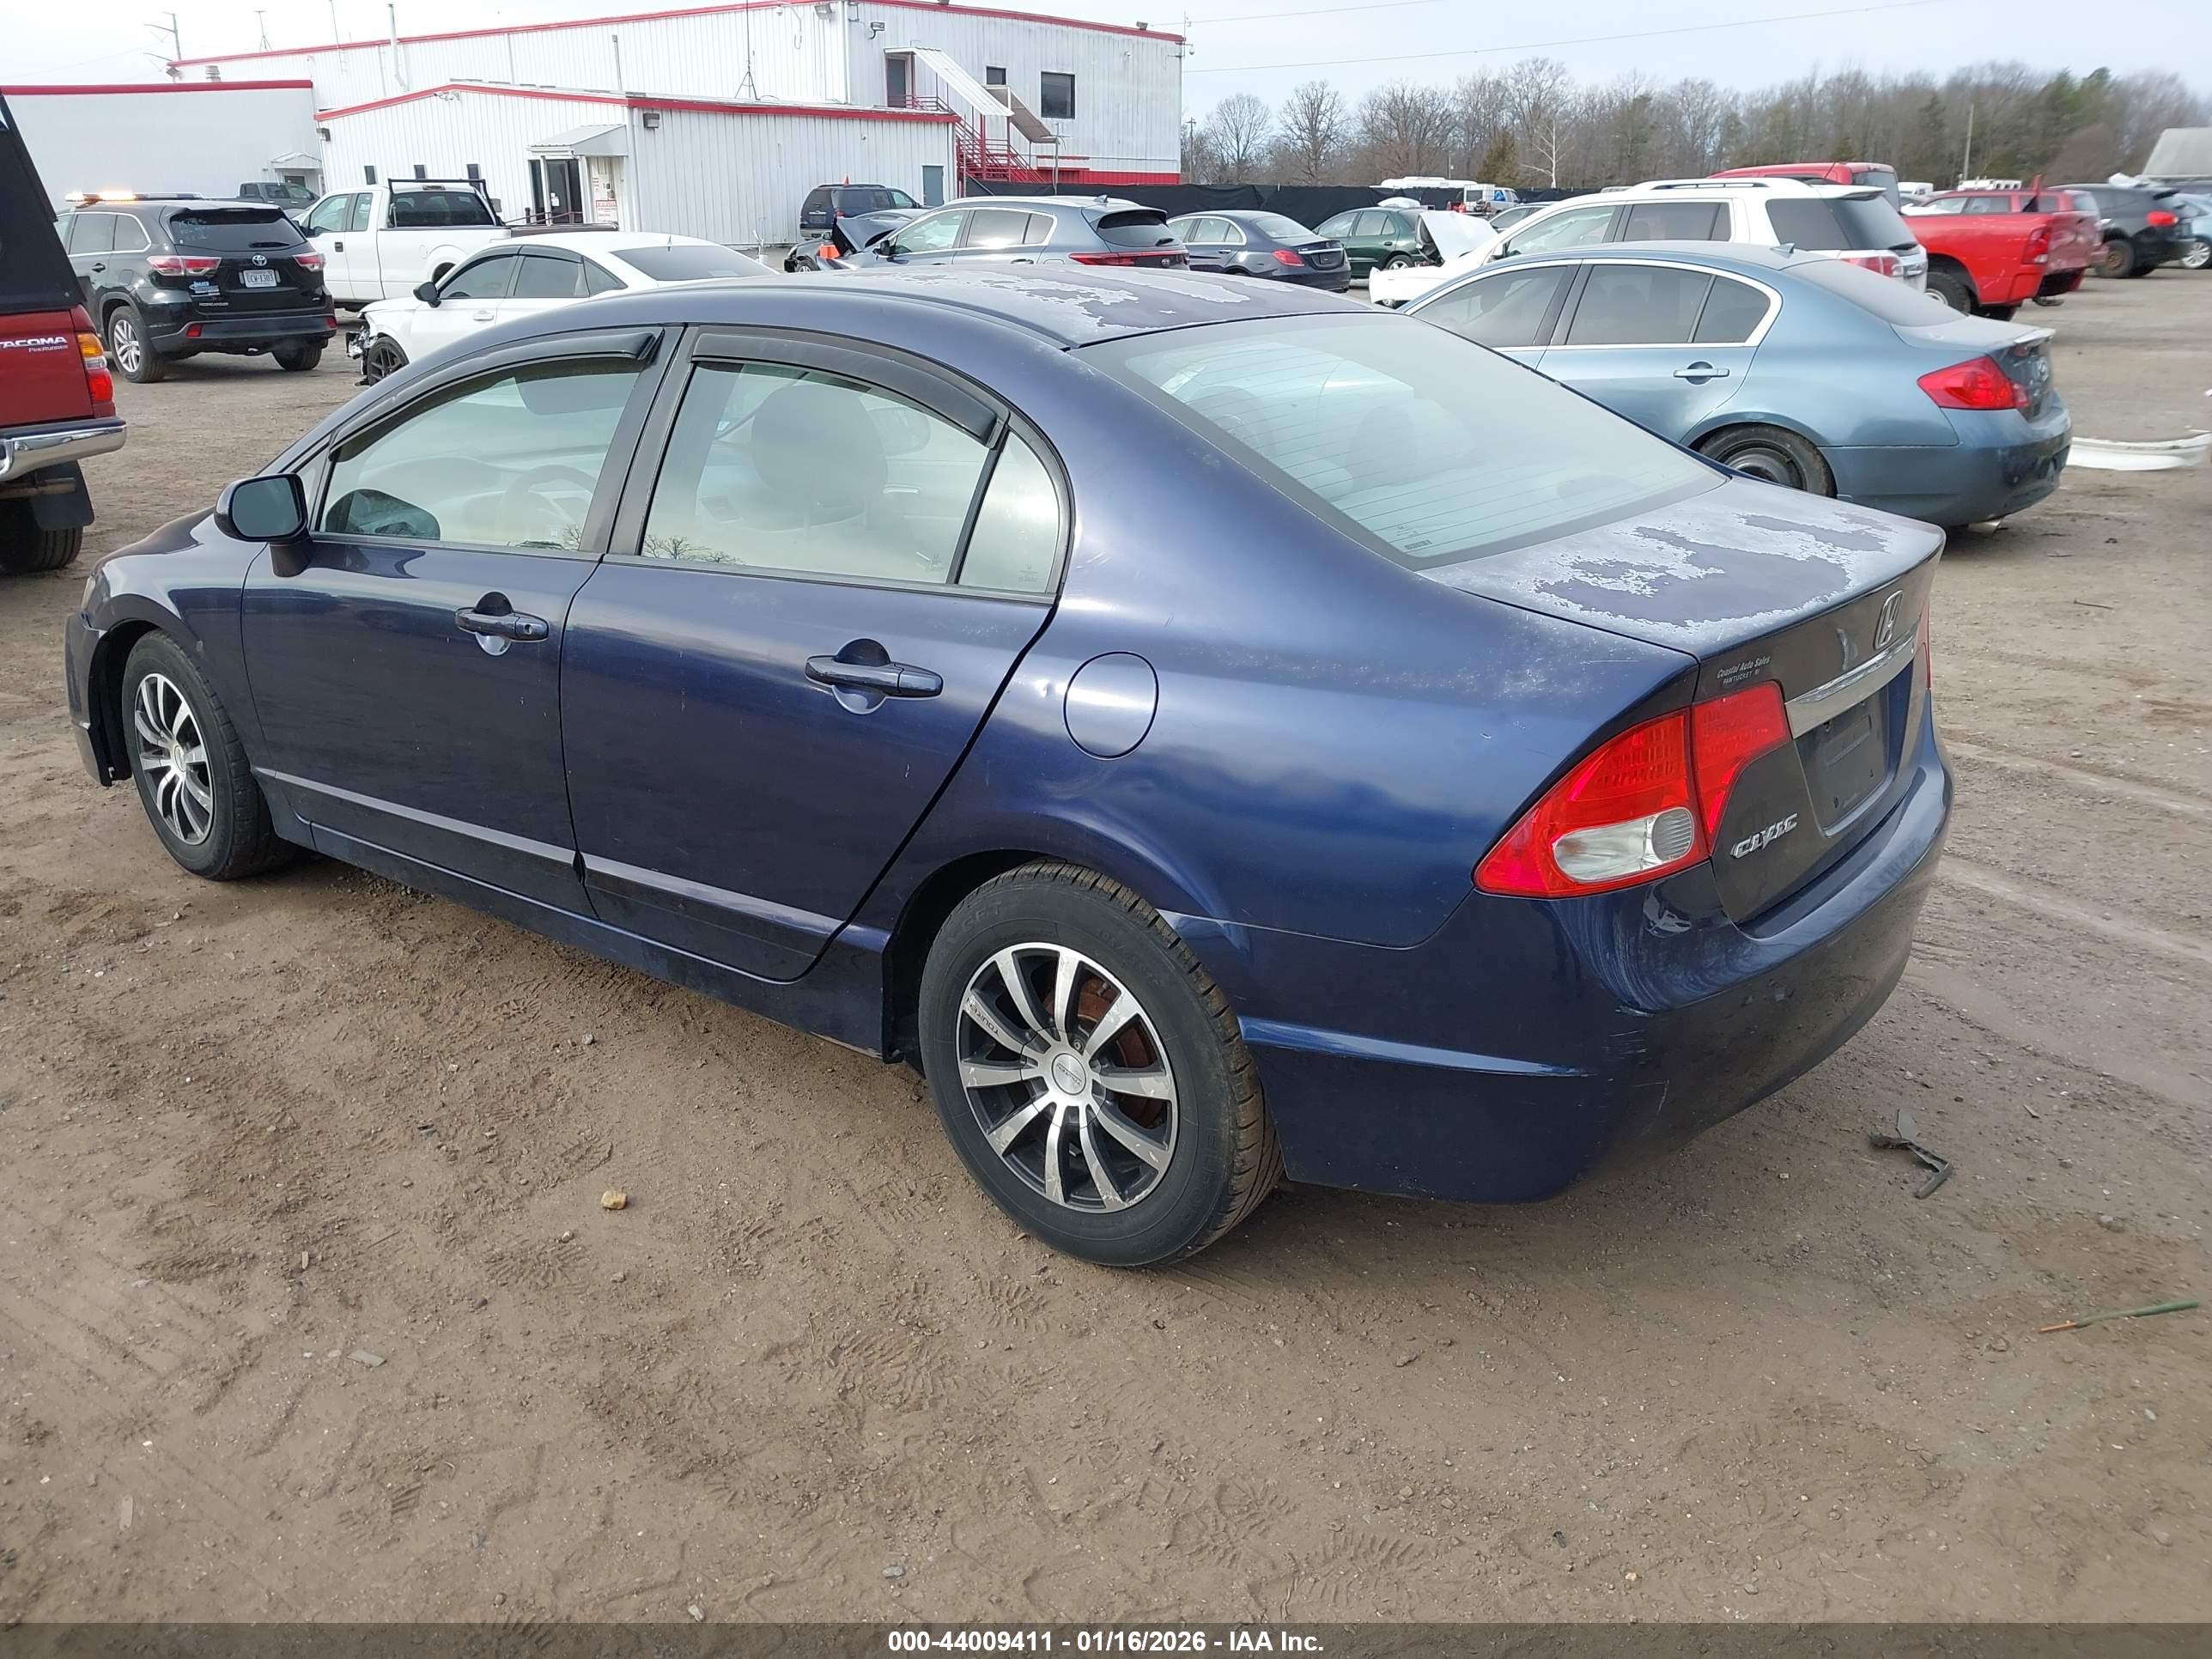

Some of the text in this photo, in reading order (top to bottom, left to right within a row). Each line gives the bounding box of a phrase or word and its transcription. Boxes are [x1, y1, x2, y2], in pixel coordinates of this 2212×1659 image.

[1739, 659, 1754, 672] Auto
[1753, 655, 1771, 668] Sales
[1730, 811, 1799, 859] CIVIC
